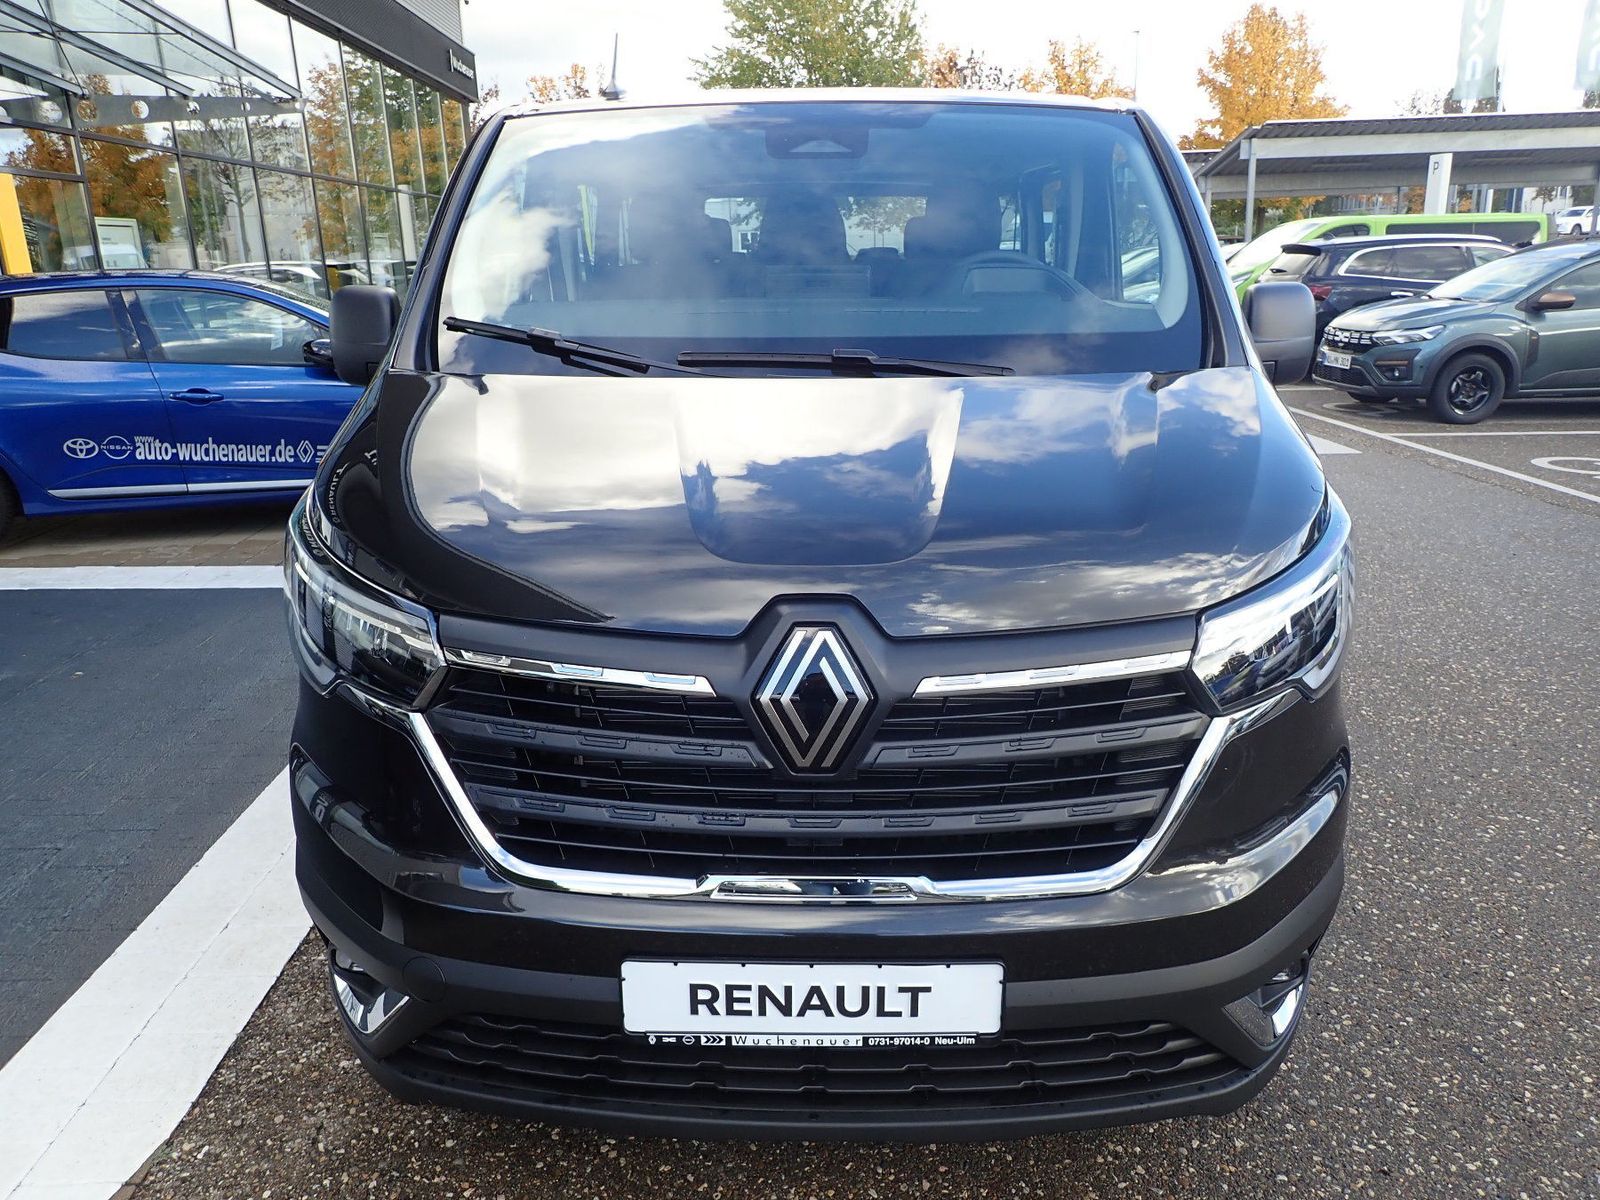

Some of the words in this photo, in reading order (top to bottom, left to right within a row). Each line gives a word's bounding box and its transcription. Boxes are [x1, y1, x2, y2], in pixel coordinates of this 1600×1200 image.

[1433, 161, 1440, 175] P
[135, 437, 295, 463] auto-wuchenauer.de
[689, 983, 932, 1018] RENAULT
[734, 1035, 862, 1047] Wuchenauer
[868, 1036, 931, 1046] 0731-97014-0
[934, 1036, 976, 1045] Neu-Ulm
